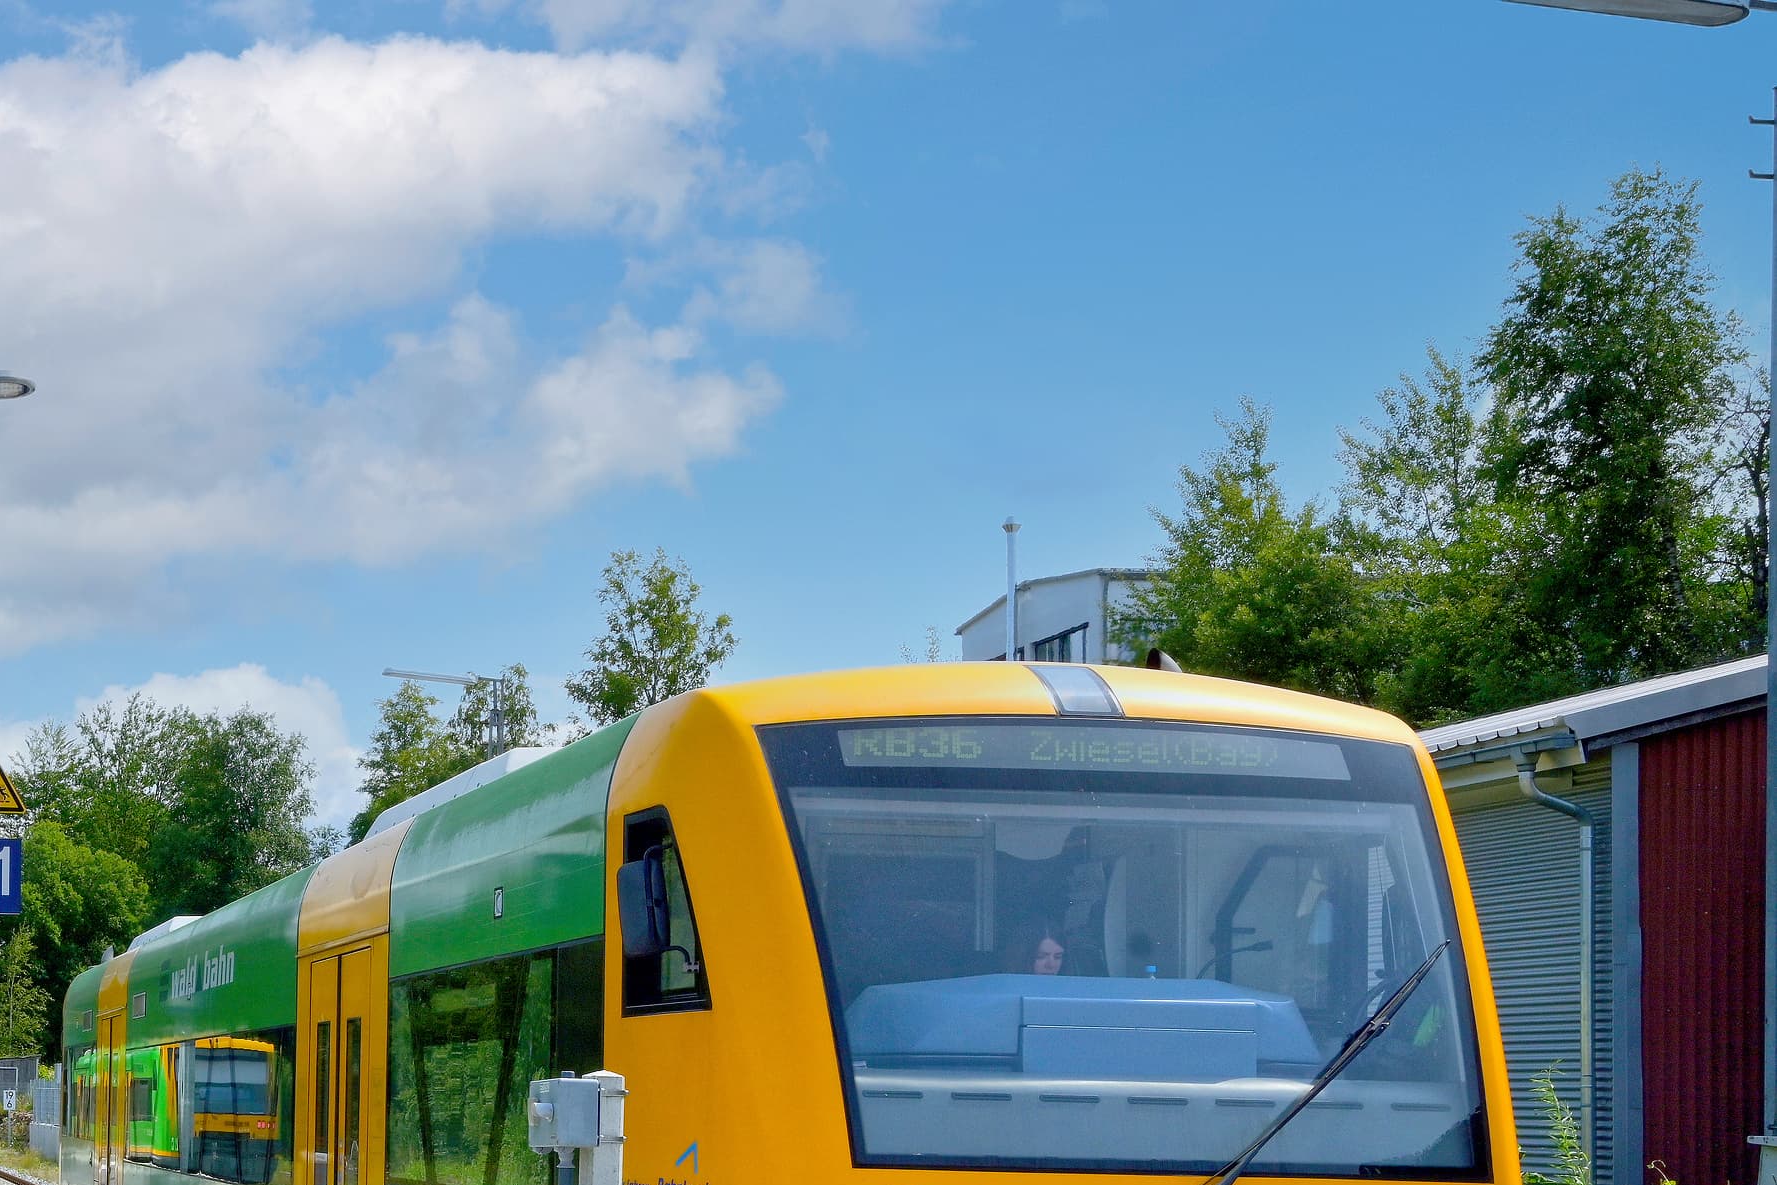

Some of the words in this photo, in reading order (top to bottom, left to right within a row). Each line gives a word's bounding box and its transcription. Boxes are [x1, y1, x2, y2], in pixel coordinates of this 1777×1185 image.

[854, 730, 982, 759] RB36
[171, 953, 198, 1001] wald
[203, 944, 235, 991] bahn
[6, 1100, 13, 1109] 6
